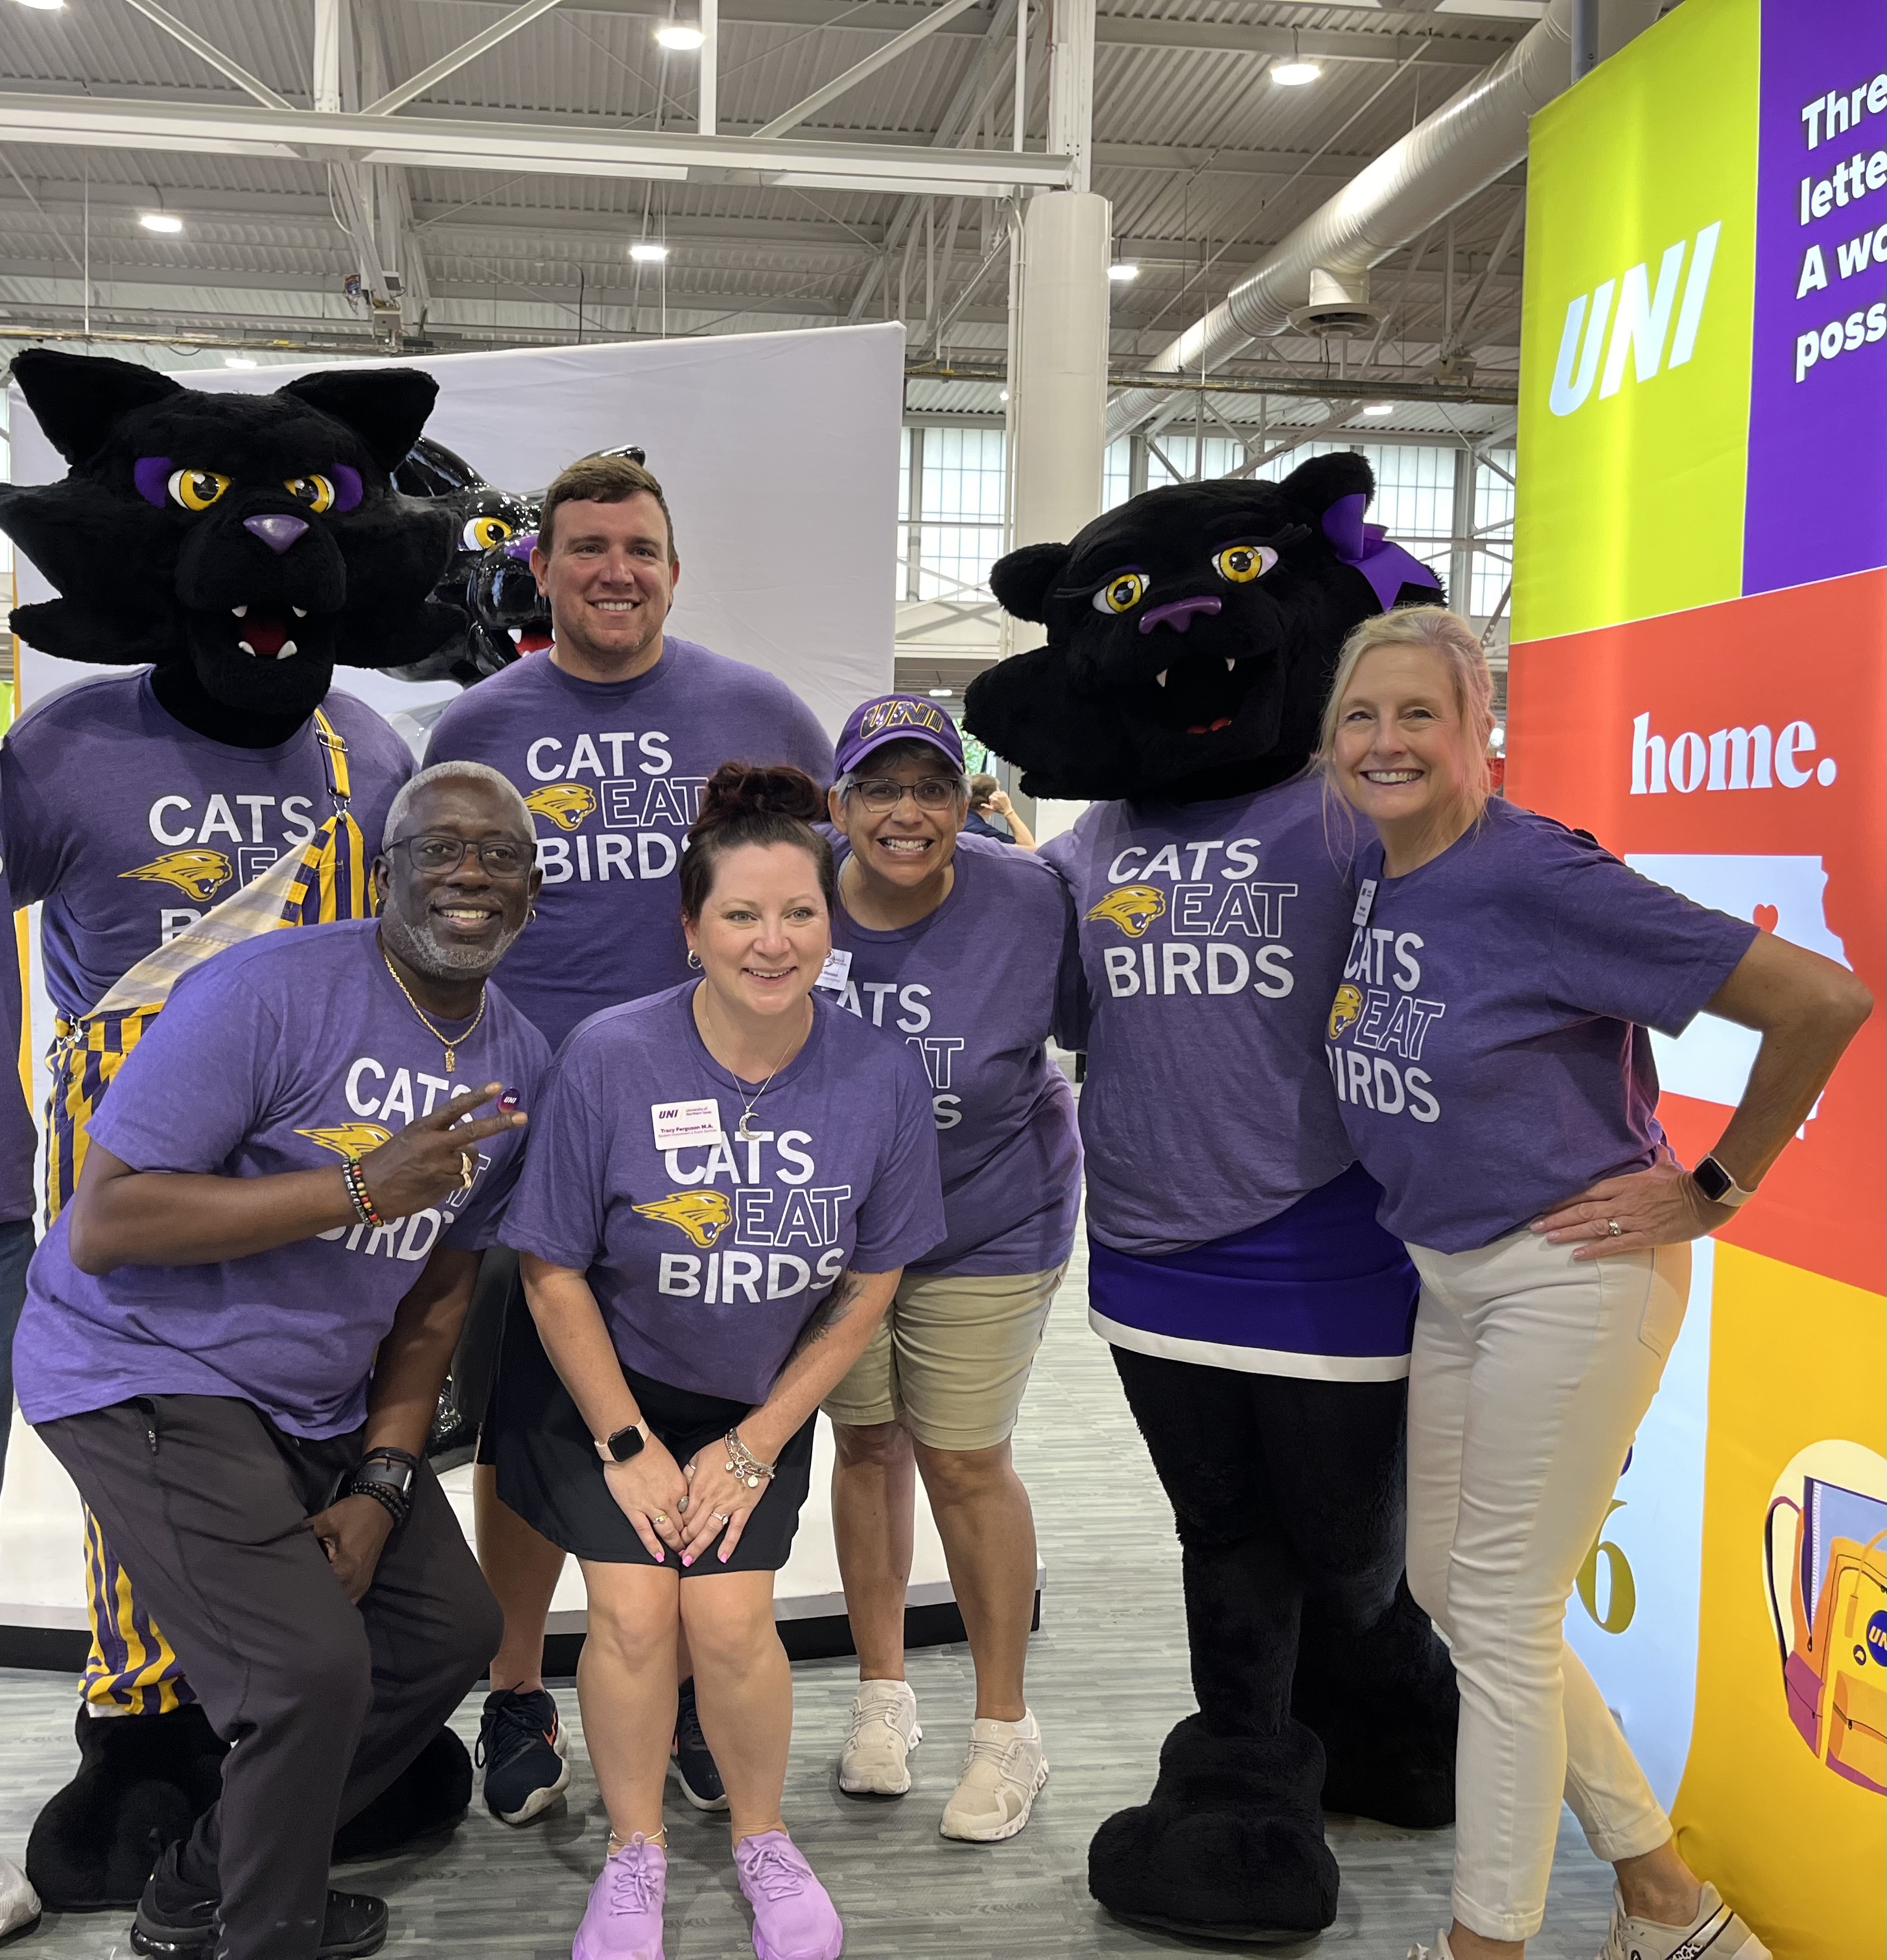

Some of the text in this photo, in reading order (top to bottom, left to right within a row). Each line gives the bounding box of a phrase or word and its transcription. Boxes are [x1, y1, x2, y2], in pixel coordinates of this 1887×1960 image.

[1796, 244, 1827, 299] A
[1549, 220, 1722, 416] UNI
[1796, 303, 1887, 383] poss
[860, 701, 944, 739] UNI
[526, 731, 672, 781] CATS
[1630, 712, 1837, 795] home.
[149, 794, 316, 846] CATS
[601, 777, 709, 828] EAT
[536, 832, 691, 884] BIRD
[1108, 838, 1261, 884] CATS
[1171, 883, 1298, 938] EAT
[1104, 942, 1294, 998] BIRDS
[1343, 926, 1424, 992] CATS
[823, 981, 932, 1033] ATS
[1354, 989, 1446, 1061] EAT
[659, 1110, 679, 1119] UNI
[665, 1130, 815, 1185] CATS
[734, 1185, 851, 1247] EAT
[658, 1248, 844, 1304] BIRDS
